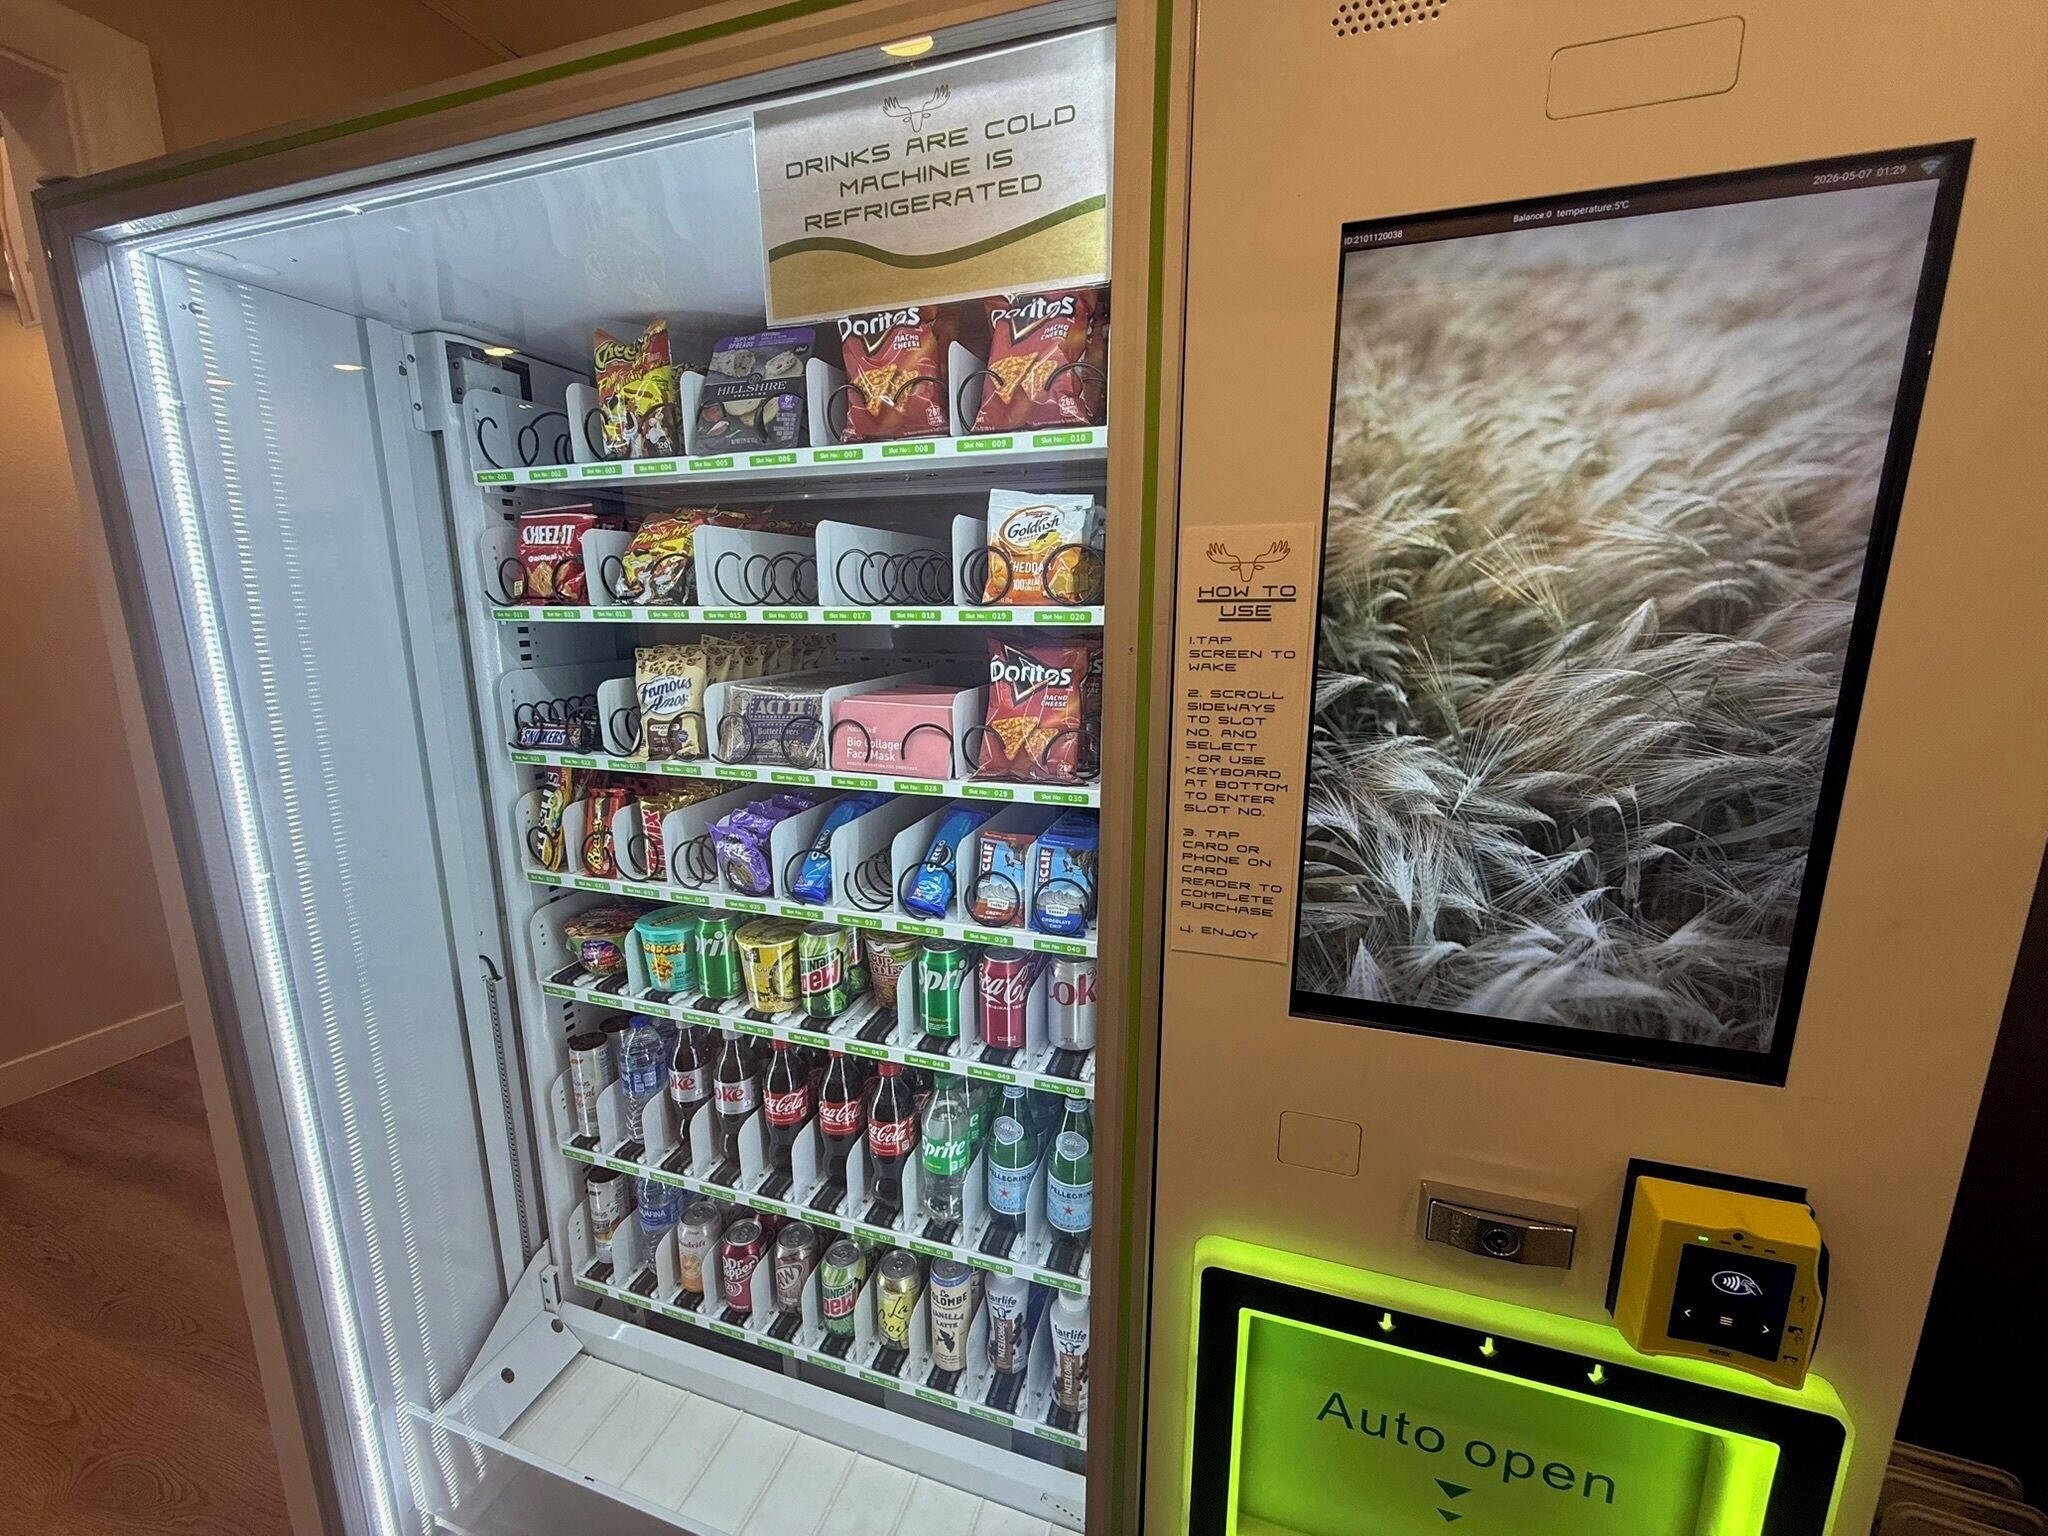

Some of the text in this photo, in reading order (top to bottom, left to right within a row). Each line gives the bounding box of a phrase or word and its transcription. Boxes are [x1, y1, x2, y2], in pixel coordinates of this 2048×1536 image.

[786, 104, 1076, 180] DRINKS ARE COLD
[839, 149, 1013, 197] MACHINE IS
[1812, 164, 1907, 185] 2026-05-07 01:29
[804, 173, 1042, 232] REFRIGERATED
[1344, 229, 1403, 245] ID:2101120038
[991, 296, 1075, 329] Doritos
[838, 307, 920, 342] Doritos
[717, 381, 787, 396] HILLSHIRE
[991, 439, 1007, 449] 009
[1070, 433, 1086, 443] 010
[1007, 514, 1060, 538] Goldfish
[1198, 585, 1297, 597] HOW TO
[992, 612, 1007, 620] 019
[1070, 613, 1086, 621] 020
[1220, 605, 1272, 617] USE
[1189, 650, 1296, 659] SCREEN TO
[990, 658, 1073, 686] Doritos
[1188, 663, 1237, 672] WAKE
[640, 678, 692, 704] Famous
[1187, 689, 1284, 700] 2. SCROLL
[755, 700, 807, 715] ACT II
[1187, 703, 1276, 713] SIDEWAYS
[1187, 715, 1267, 726] TO SLOT
[522, 729, 566, 744] SNIKERS
[1186, 728, 1257, 739] NO. AND
[847, 736, 862, 747] Bio
[1186, 740, 1258, 752] SELECT
[870, 749, 896, 762] Mask
[1198, 754, 1222, 763] OR
[1229, 755, 1266, 765] USE
[1185, 766, 1281, 779] KEYBOARD
[1185, 779, 1288, 793] AT BOTTOM
[993, 790, 1009, 798] 029
[1067, 795, 1083, 803] 030
[1185, 791, 1275, 804] TO ENTER
[1184, 804, 1265, 817] SLOT NO.
[1183, 828, 1240, 839] 3. TAP
[1183, 840, 1260, 854] CARD OR
[981, 842, 995, 873] CLIF
[1039, 848, 1052, 875] CLIF
[1182, 853, 1272, 868] PHONE ON
[1182, 865, 1228, 876] CARD
[1181, 877, 1282, 893] READER TO
[1180, 888, 1274, 905] COMPLETE
[1180, 900, 1273, 918] PURCHASE
[1180, 925, 1259, 939] 4. ENJOY
[1066, 945, 1081, 953] 040
[669, 1073, 695, 1091] oke
[714, 1084, 745, 1102] oke
[922, 1133, 965, 1158] Sprite
[987, 1290, 1017, 1306] fairlife
[1054, 1323, 1088, 1341] fairlife
[1316, 1391, 1617, 1505] Auto open
